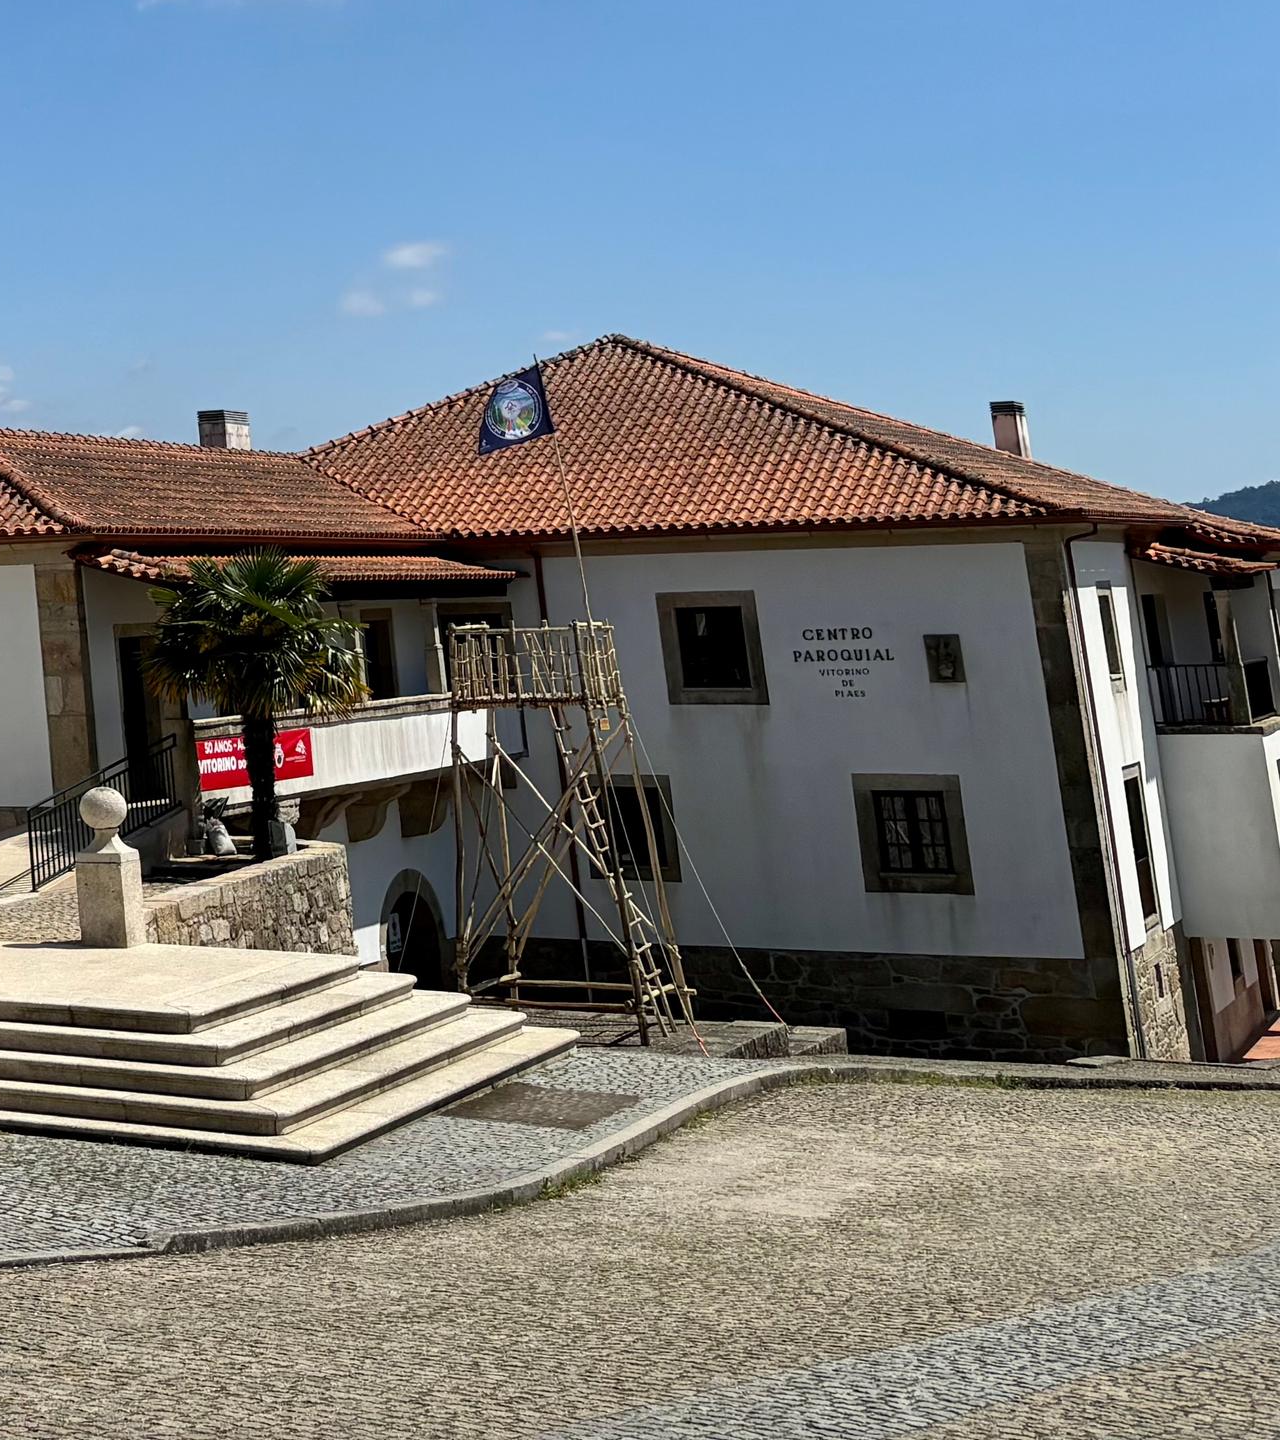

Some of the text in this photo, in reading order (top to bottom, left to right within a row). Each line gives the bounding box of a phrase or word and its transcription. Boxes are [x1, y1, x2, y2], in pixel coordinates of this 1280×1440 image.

[802, 627, 873, 641] CENTRO
[793, 648, 895, 662] PAROQUIAL
[819, 667, 870, 676] VITORINO
[841, 679, 855, 687] DE
[204, 742, 213, 754] 50
[214, 740, 233, 753] ANOS
[197, 756, 237, 774] VITORINO
